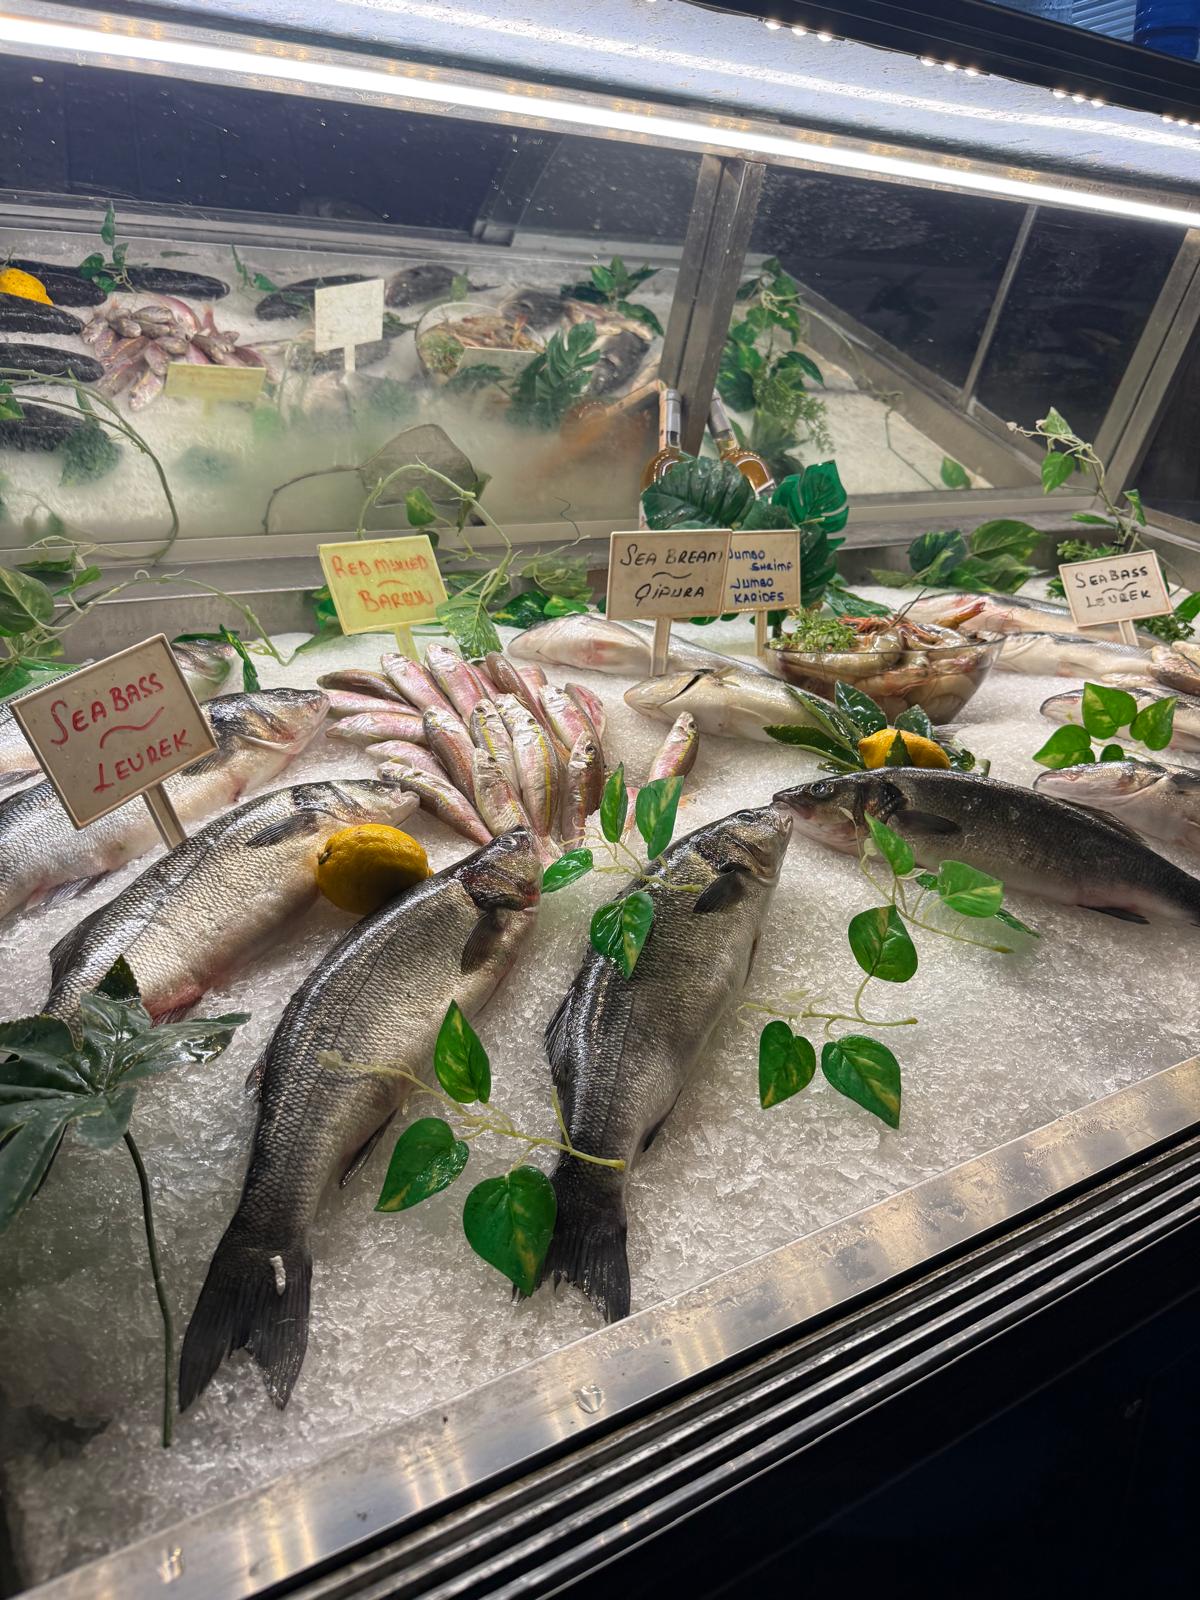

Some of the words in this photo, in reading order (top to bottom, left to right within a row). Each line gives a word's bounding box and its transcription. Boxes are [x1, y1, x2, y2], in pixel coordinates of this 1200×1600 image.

[331, 554, 372, 578] RED
[620, 543, 658, 566] SEA
[665, 547, 723, 565] BREAM
[730, 577, 774, 589] JUMBO
